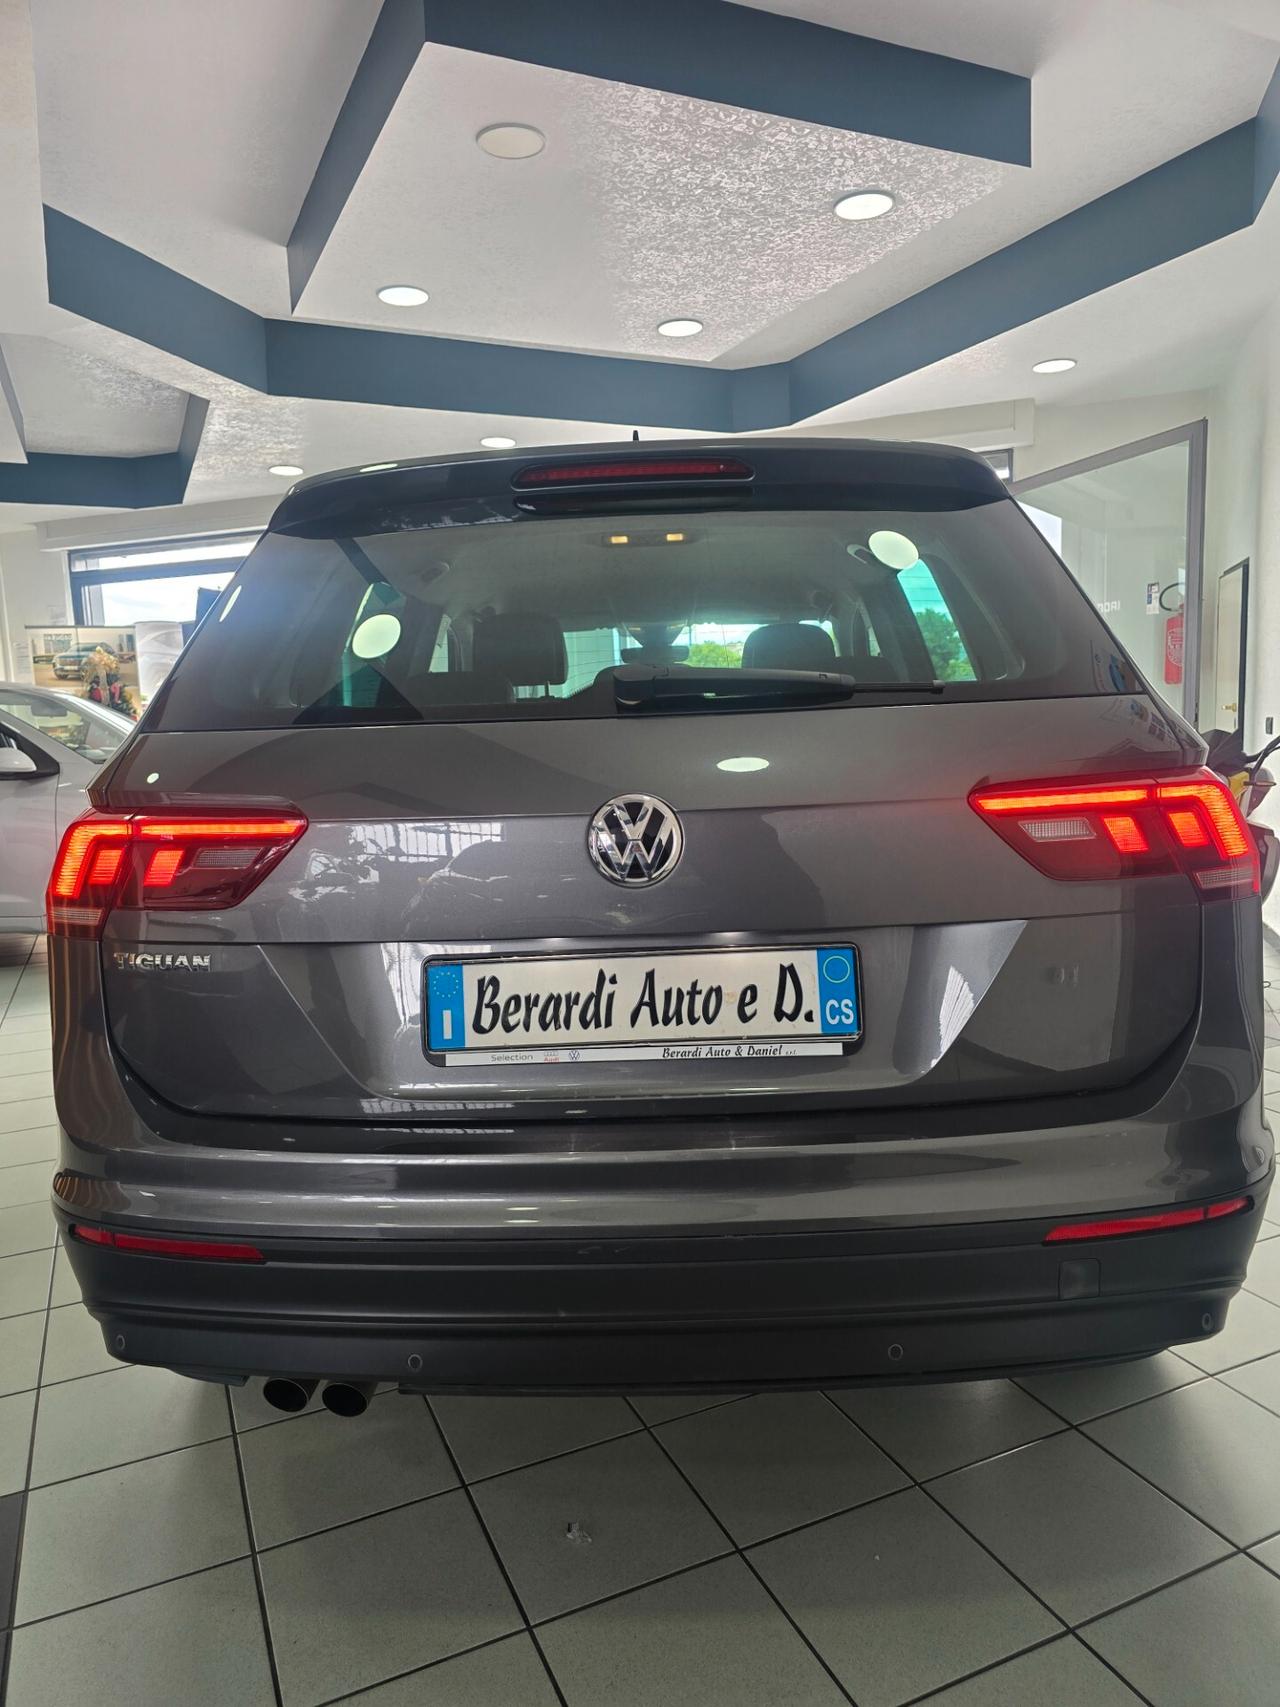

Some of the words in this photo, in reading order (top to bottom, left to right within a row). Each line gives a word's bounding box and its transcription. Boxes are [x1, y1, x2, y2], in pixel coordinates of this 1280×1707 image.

[113, 952, 211, 972] TIGUAN
[472, 967, 618, 1034] Berardi
[630, 968, 723, 1027] Auto
[737, 983, 758, 1024] e
[773, 962, 815, 1023] D.
[825, 999, 854, 1025] CS
[442, 1009, 453, 1040] I
[490, 1053, 534, 1062] Selection
[662, 1047, 702, 1059] Berardi
[705, 1046, 731, 1057] Auto
[734, 1045, 743, 1057] &
[747, 1045, 783, 1056] Daniel
